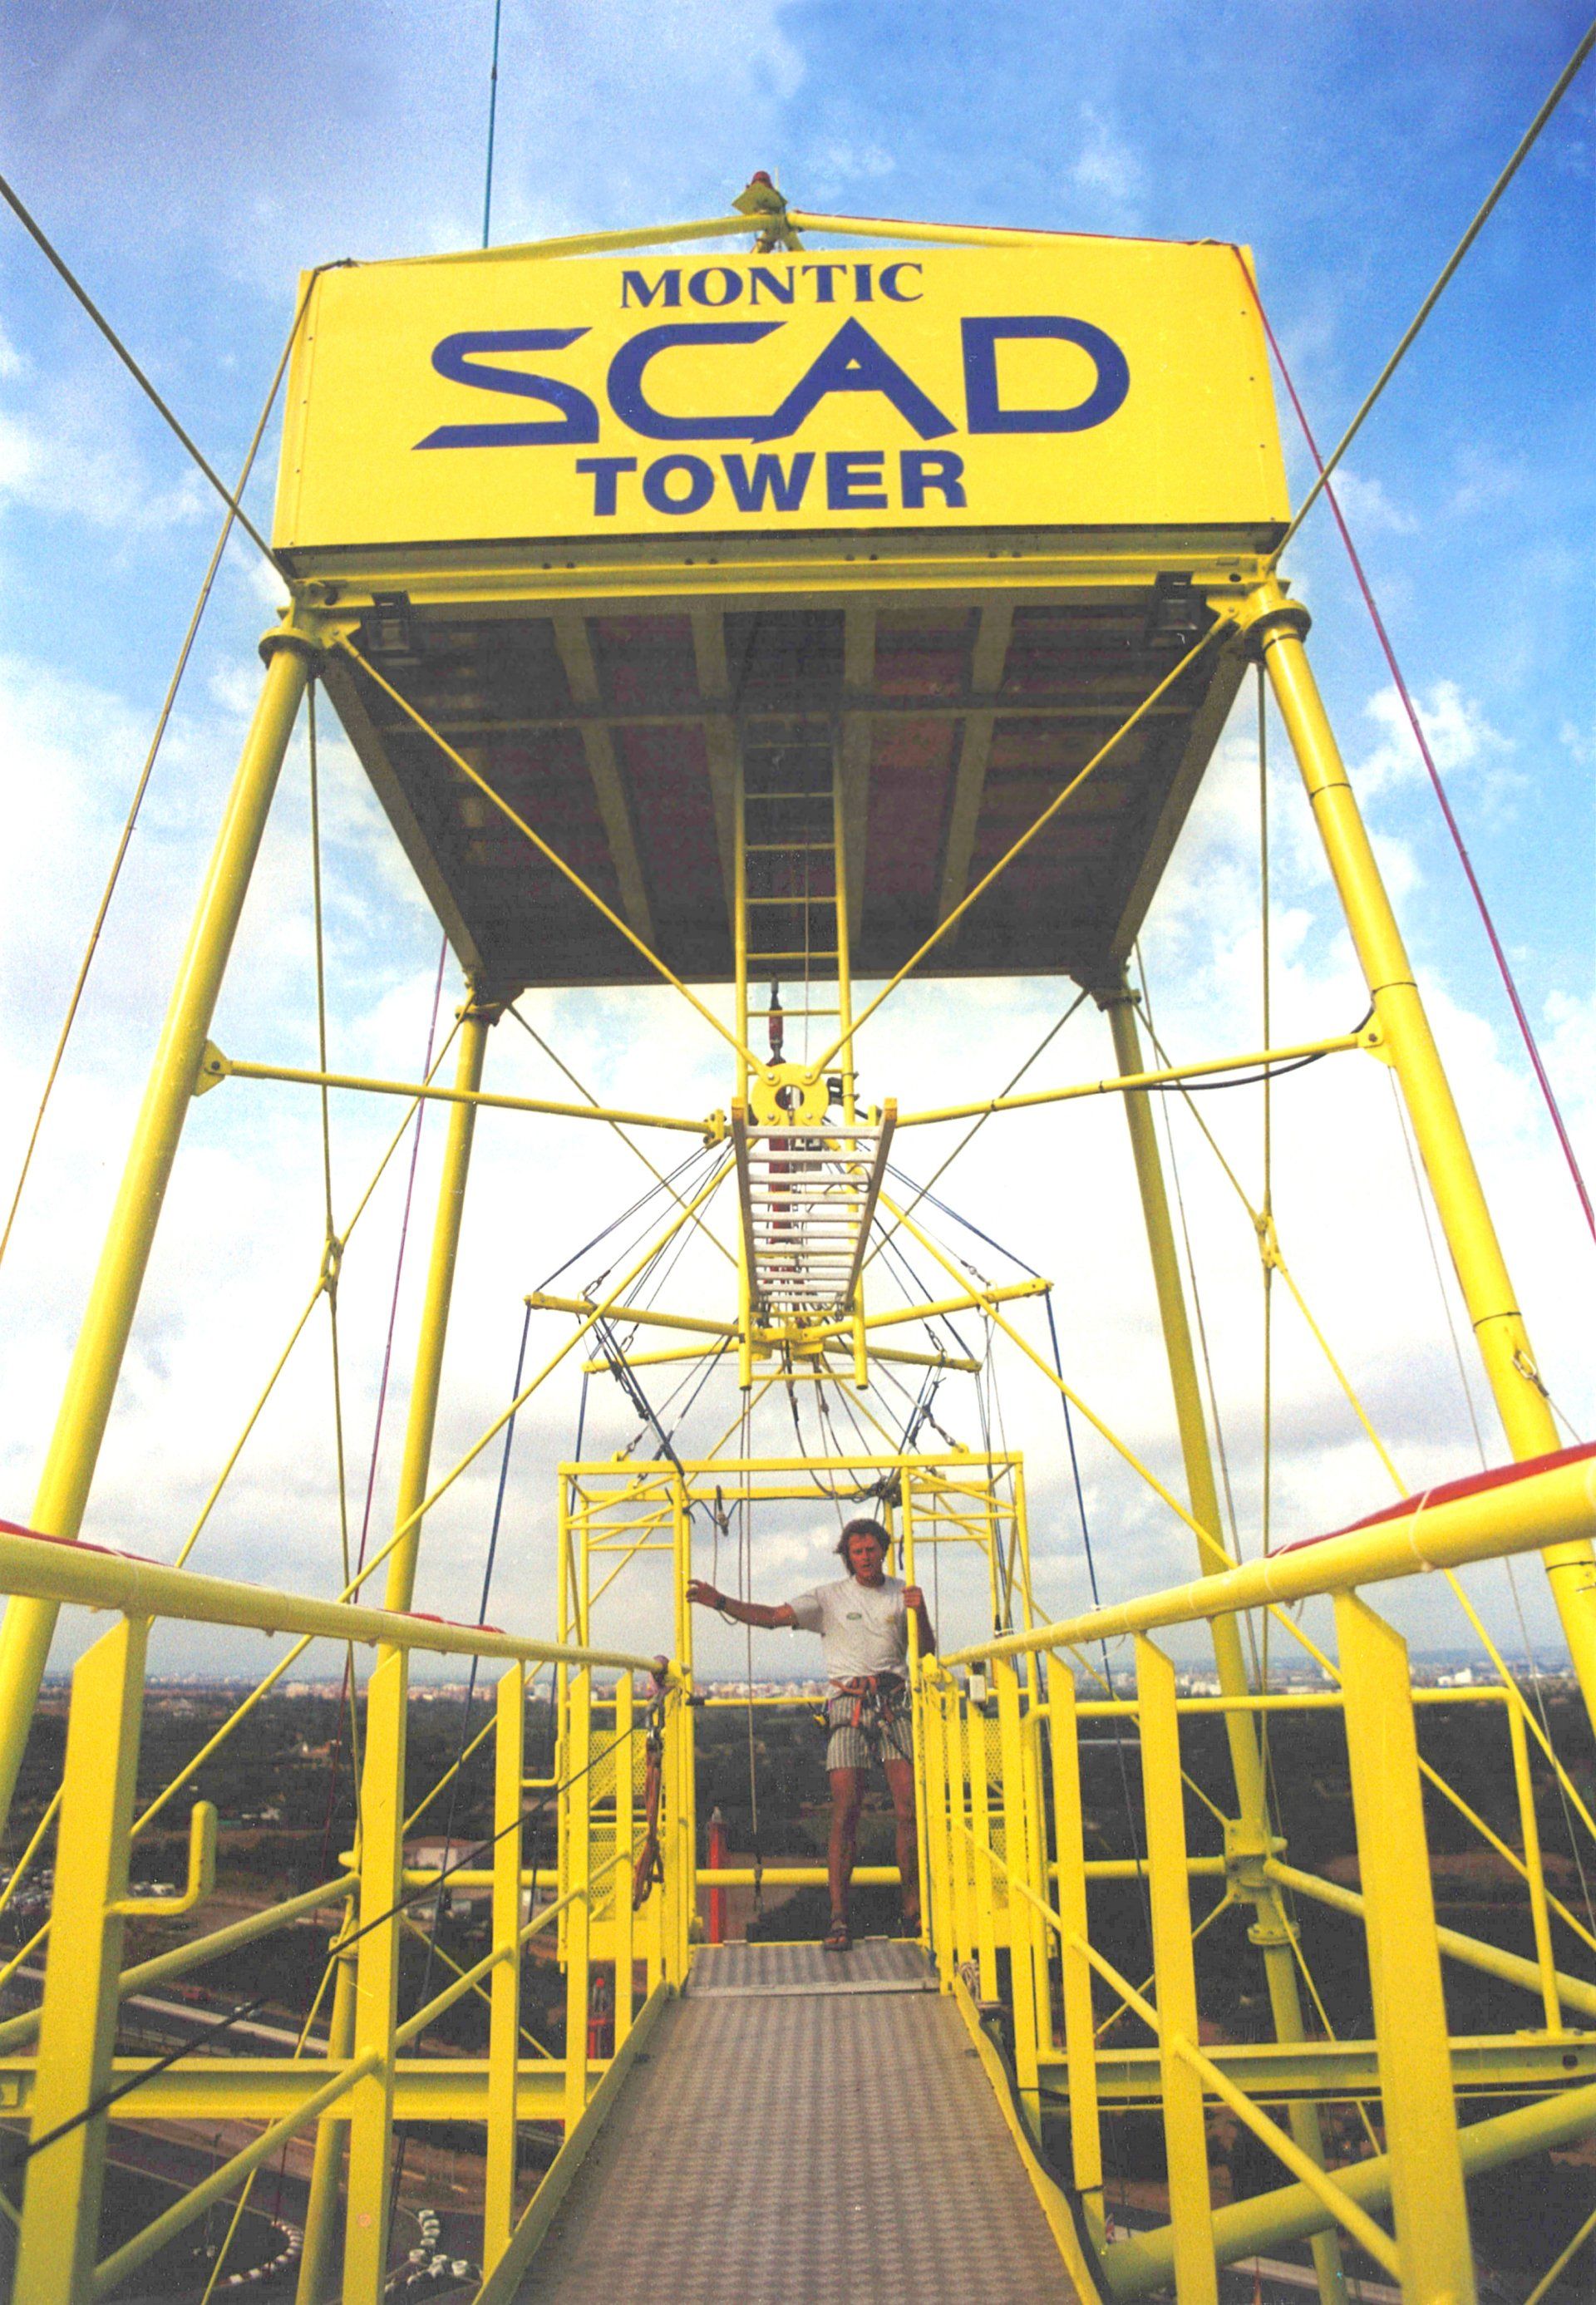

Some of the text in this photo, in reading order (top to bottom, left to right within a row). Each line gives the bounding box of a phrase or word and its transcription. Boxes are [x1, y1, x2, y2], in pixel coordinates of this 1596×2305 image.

[622, 263, 924, 308] MONTIC
[413, 317, 1130, 449] SCAD
[576, 450, 967, 516] TOWER
